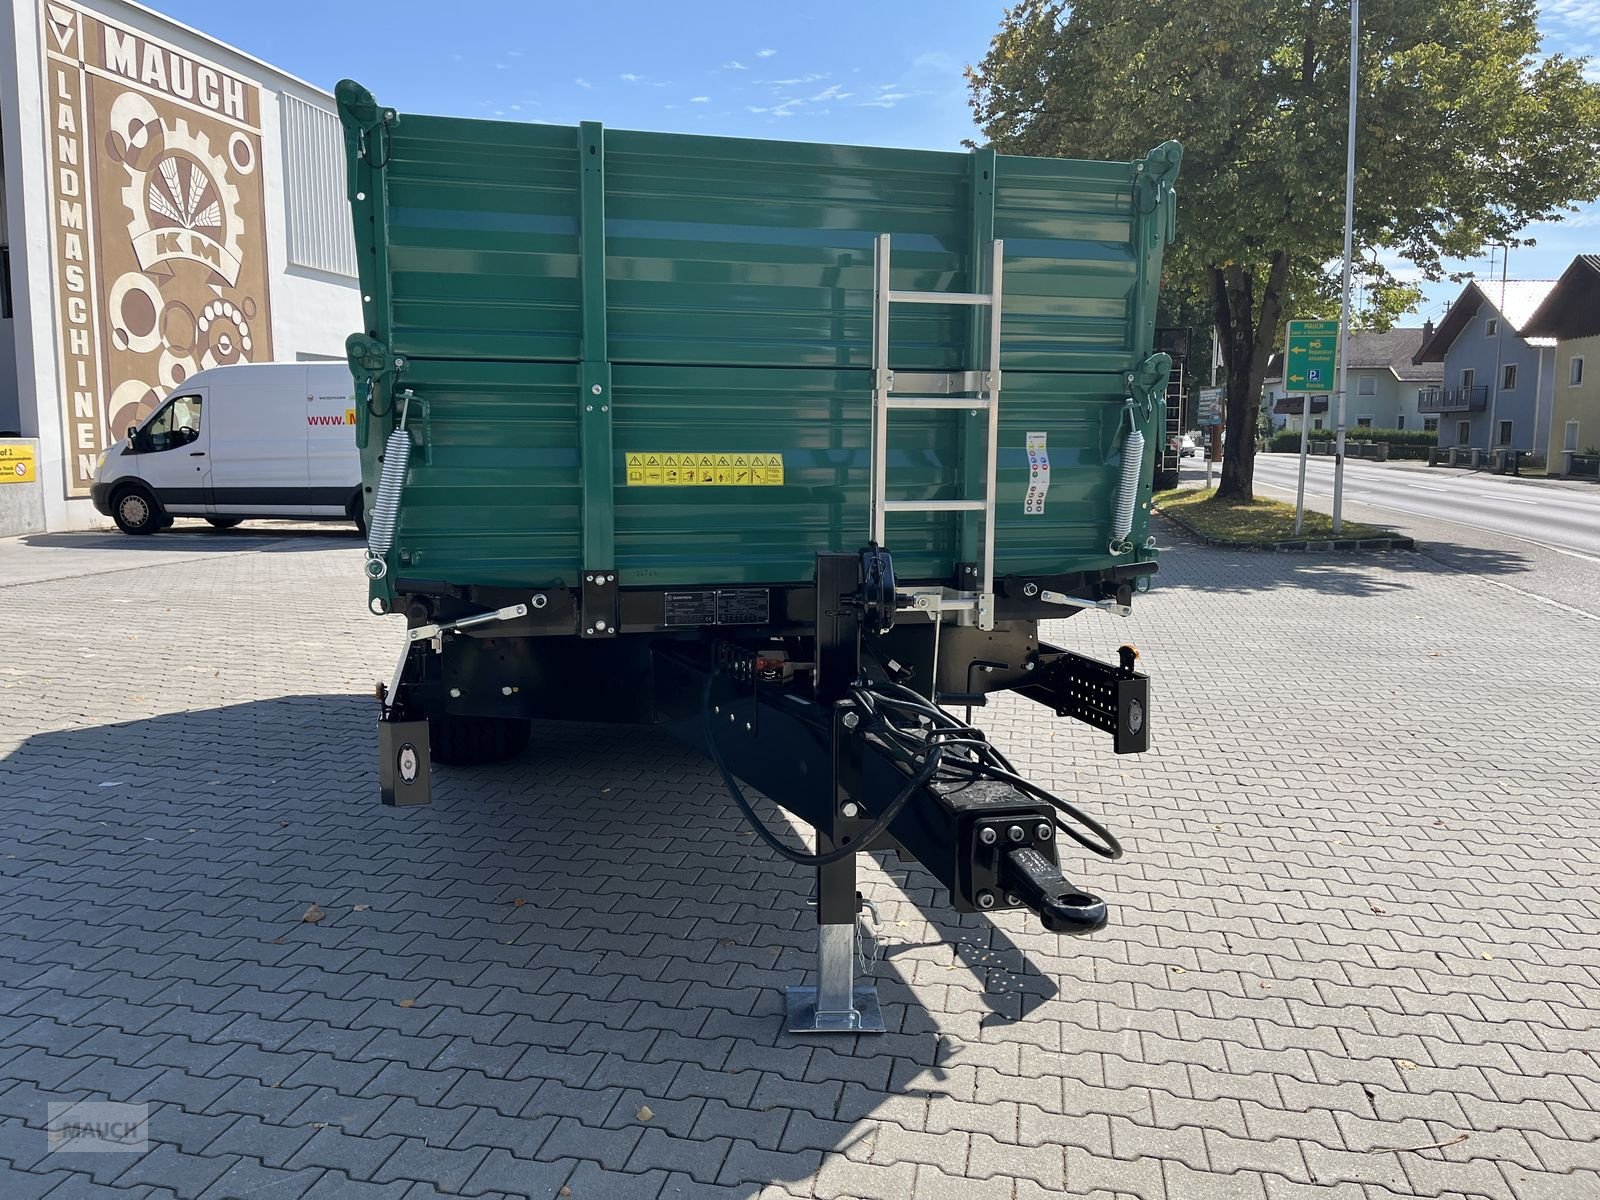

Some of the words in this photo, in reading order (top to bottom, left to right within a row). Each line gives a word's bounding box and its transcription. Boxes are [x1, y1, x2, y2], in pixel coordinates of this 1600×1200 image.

[102, 24, 246, 121] MAUCH
[56, 70, 97, 481] LANDMASCHINEN
[156, 231, 222, 268] KM
